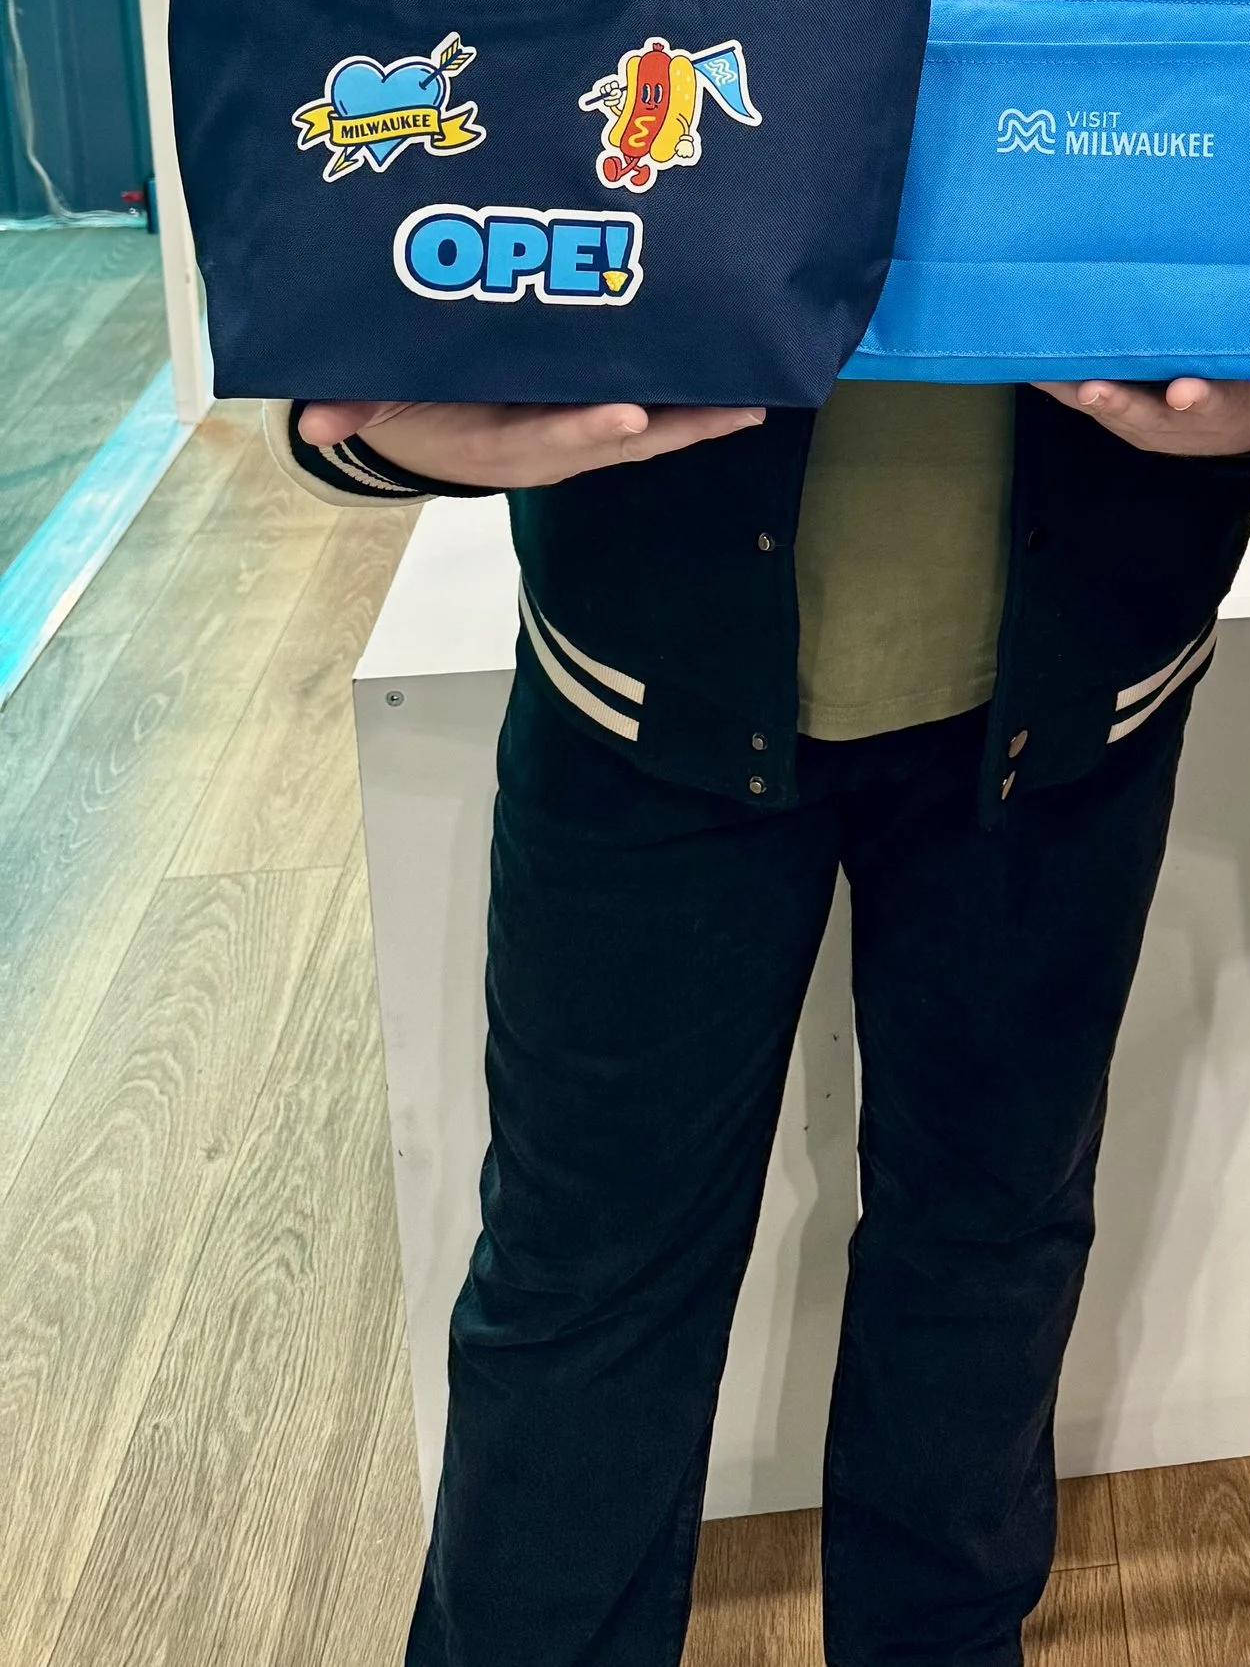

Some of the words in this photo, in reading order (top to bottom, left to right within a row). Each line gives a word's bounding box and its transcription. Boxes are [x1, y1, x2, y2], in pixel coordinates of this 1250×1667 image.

[341, 112, 431, 140] MILWAUKEE
[1066, 110, 1121, 128] VISIT
[1065, 131, 1215, 158] MILWAUKEE
[410, 218, 630, 292] OPE!
